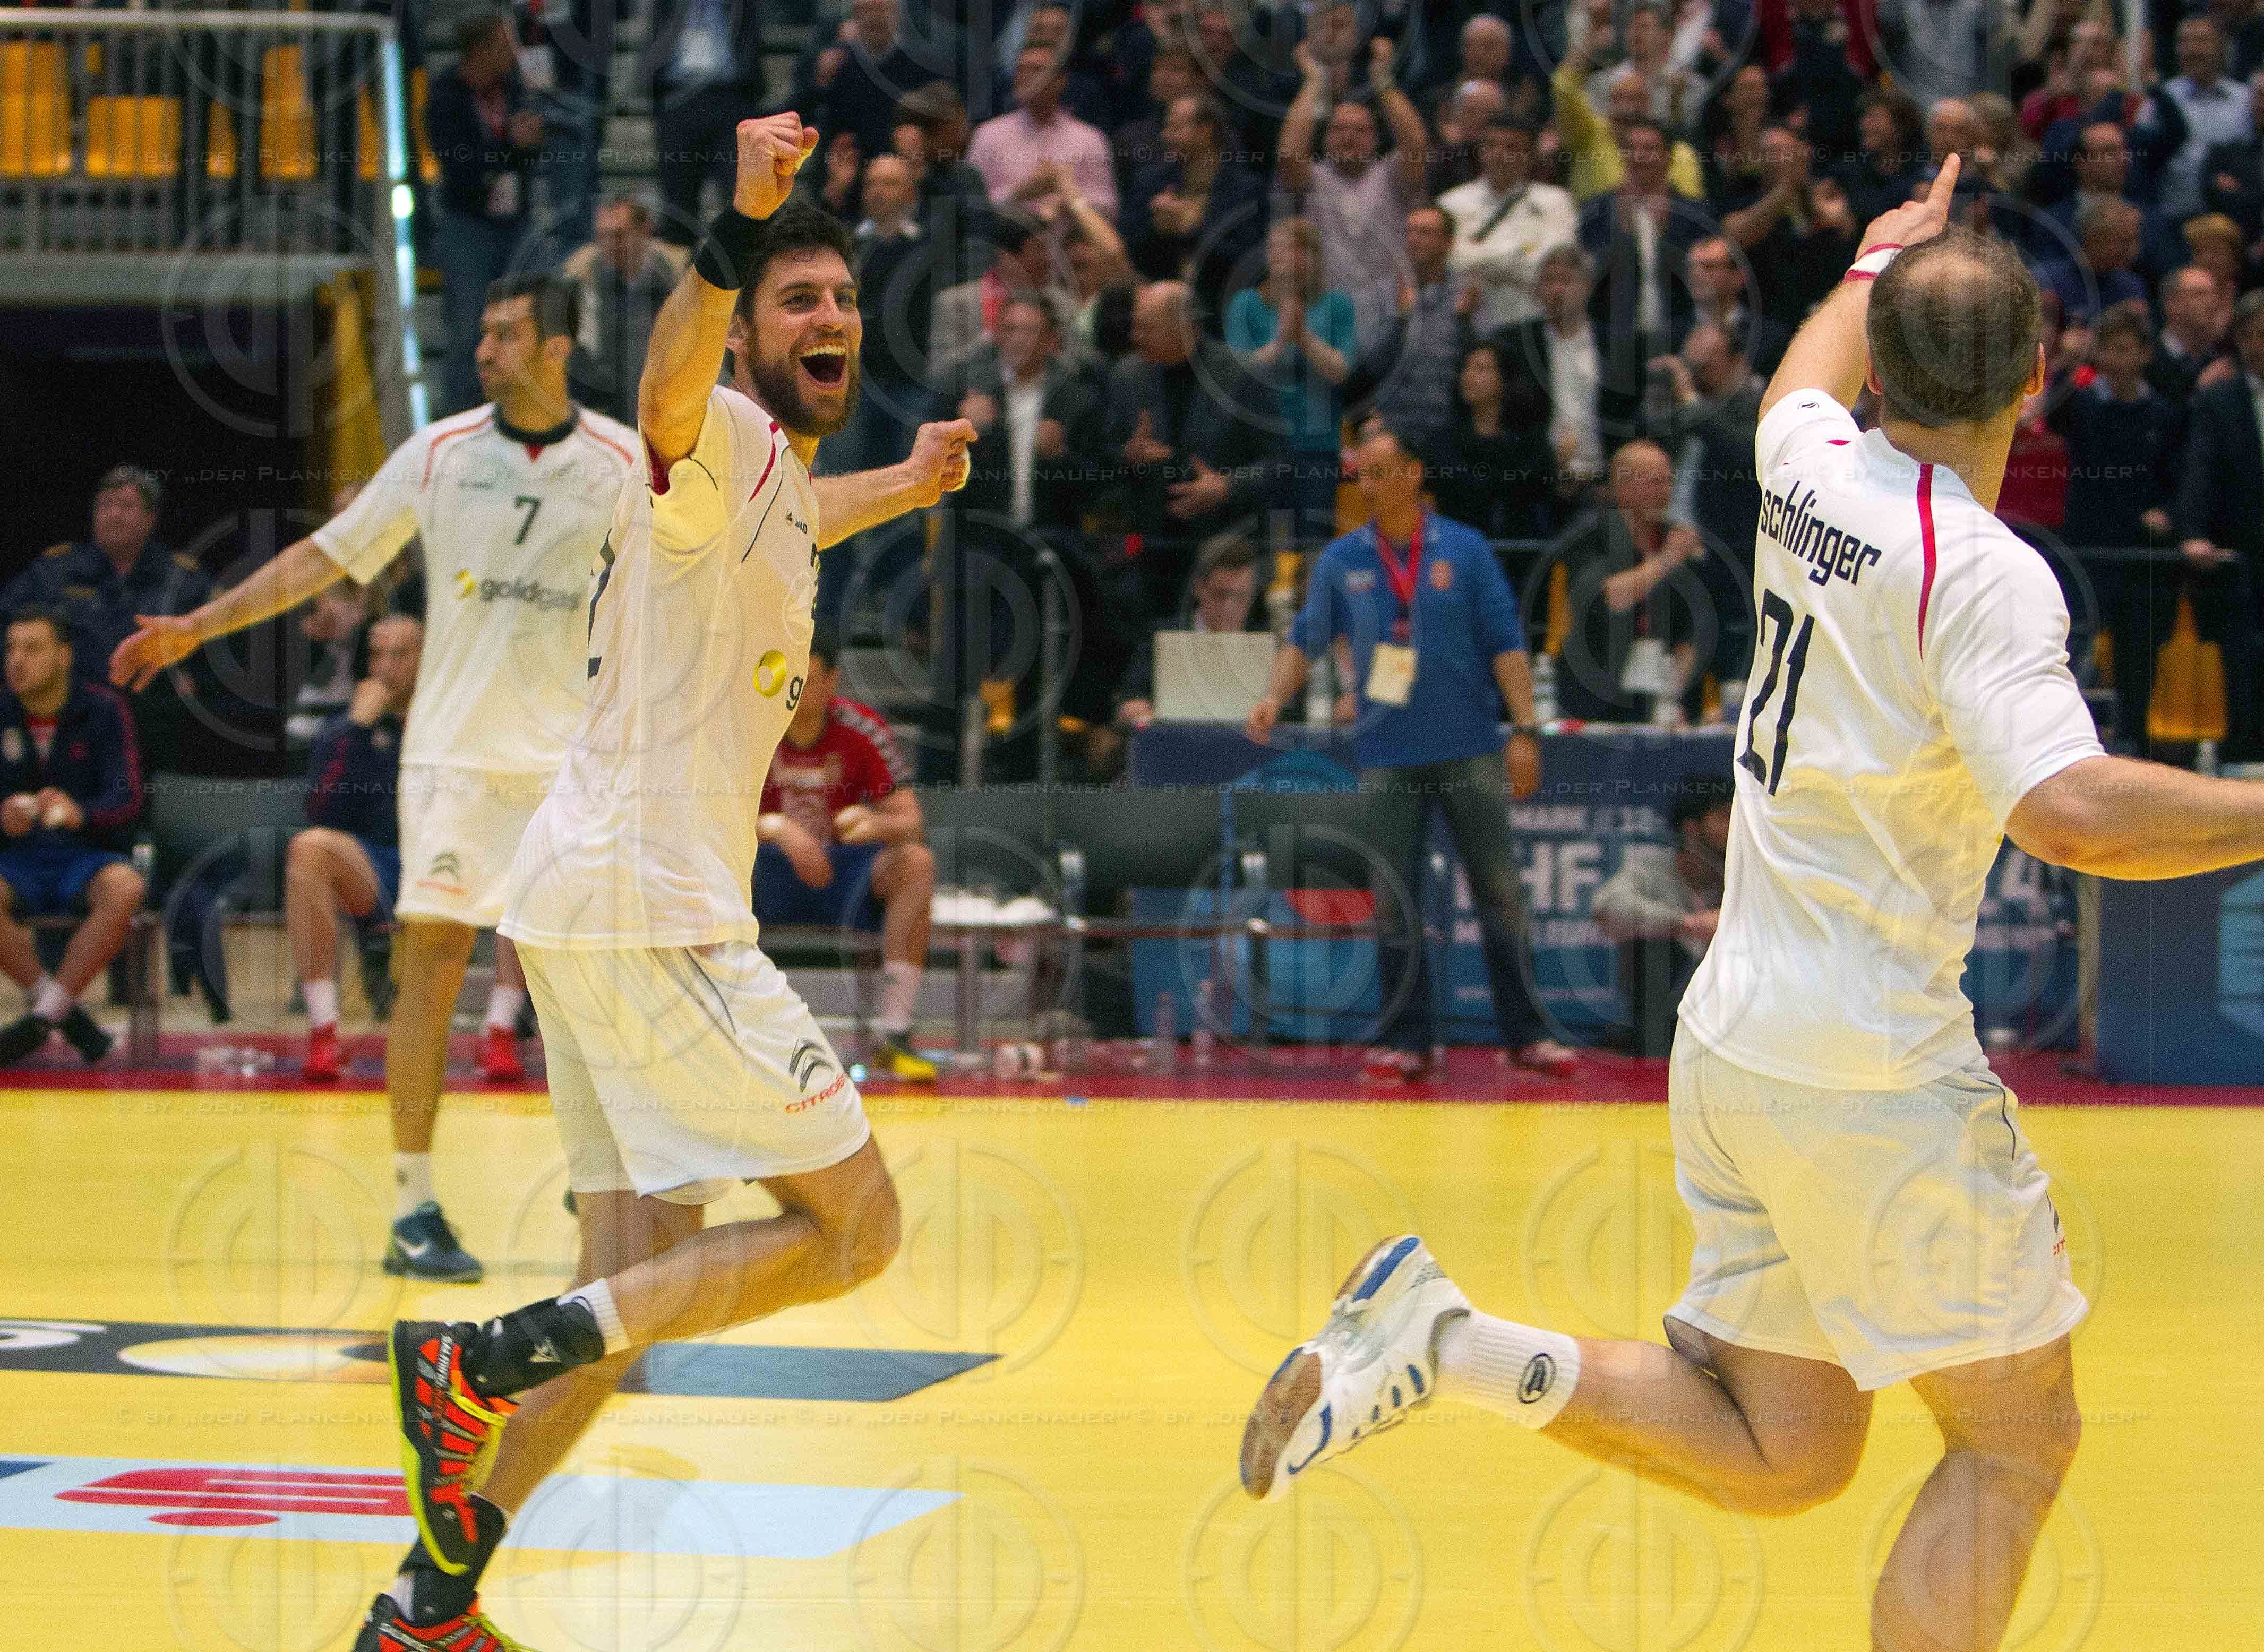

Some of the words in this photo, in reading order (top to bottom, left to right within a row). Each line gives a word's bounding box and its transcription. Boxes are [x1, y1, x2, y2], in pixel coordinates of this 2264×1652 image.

[513, 495, 543, 545] 7
[1760, 480, 1882, 586] schlinger
[1736, 589, 1815, 797] 21
